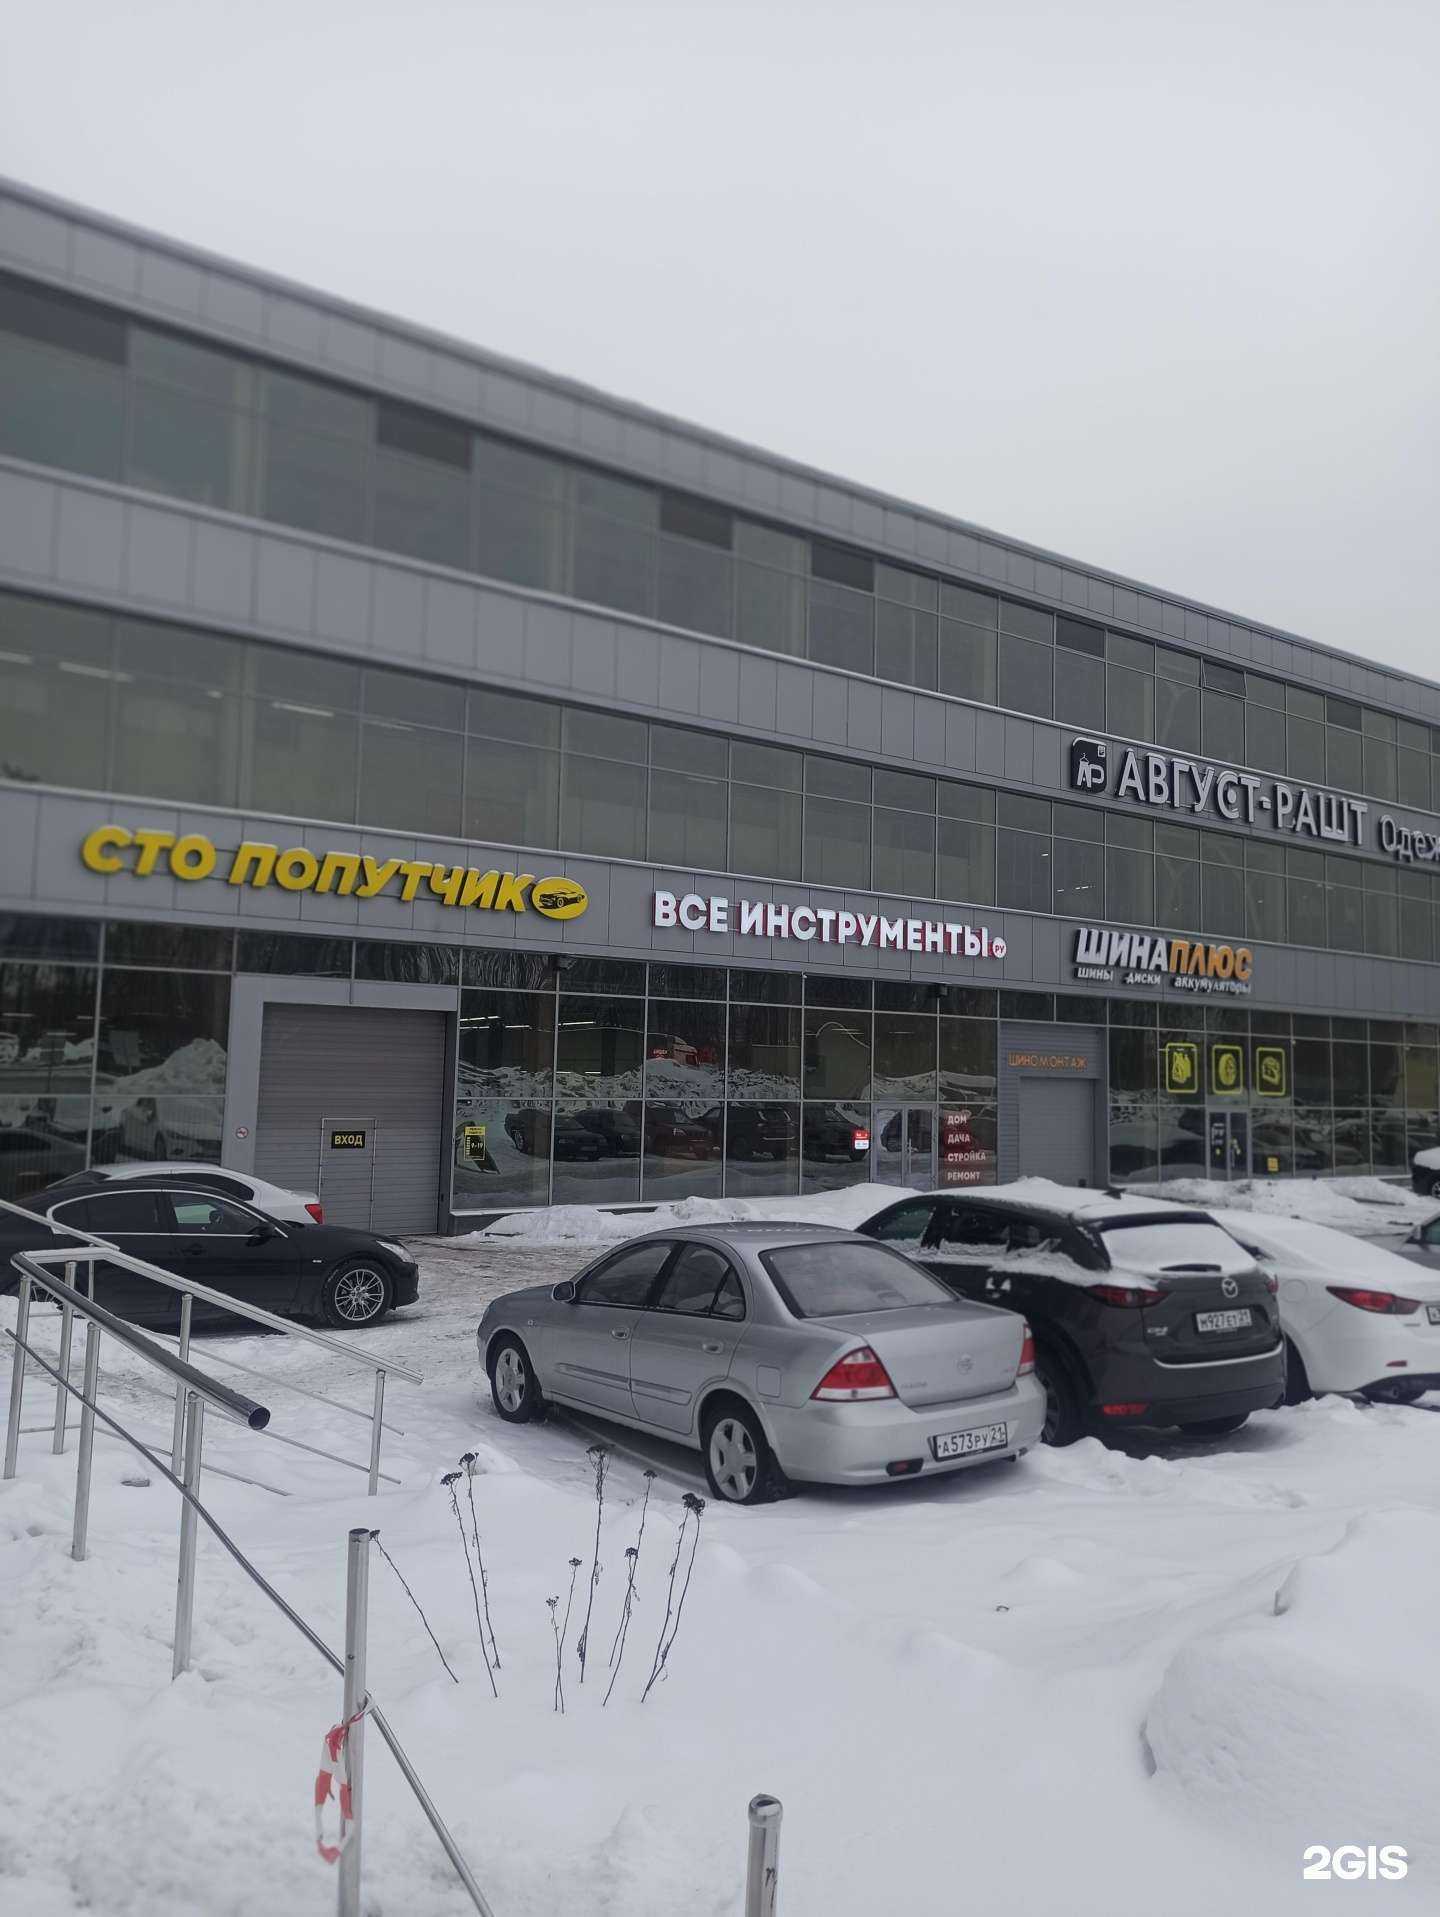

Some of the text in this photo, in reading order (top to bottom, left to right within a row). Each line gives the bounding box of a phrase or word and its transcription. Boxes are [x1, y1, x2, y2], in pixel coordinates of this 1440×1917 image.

[1118, 748, 1368, 846] АВГУСТ-РАШТ
[82, 825, 536, 912] СТО ПОПУТЧИК
[654, 890, 729, 932] ВСЕ
[740, 899, 988, 957] ИНСТРУМЕНТЫ
[1077, 967, 1114, 982] шины
[1126, 972, 1161, 985] диски
[1008, 1051, 1088, 1071] ШИНОМОНТАЖ
[947, 1115, 967, 1124] ДОМ
[334, 1134, 363, 1146] ВХОД
[947, 1133, 970, 1144] ДАЧА
[947, 1151, 986, 1162] СТРОЙКА
[947, 1171, 980, 1180] РЕМОНТ
